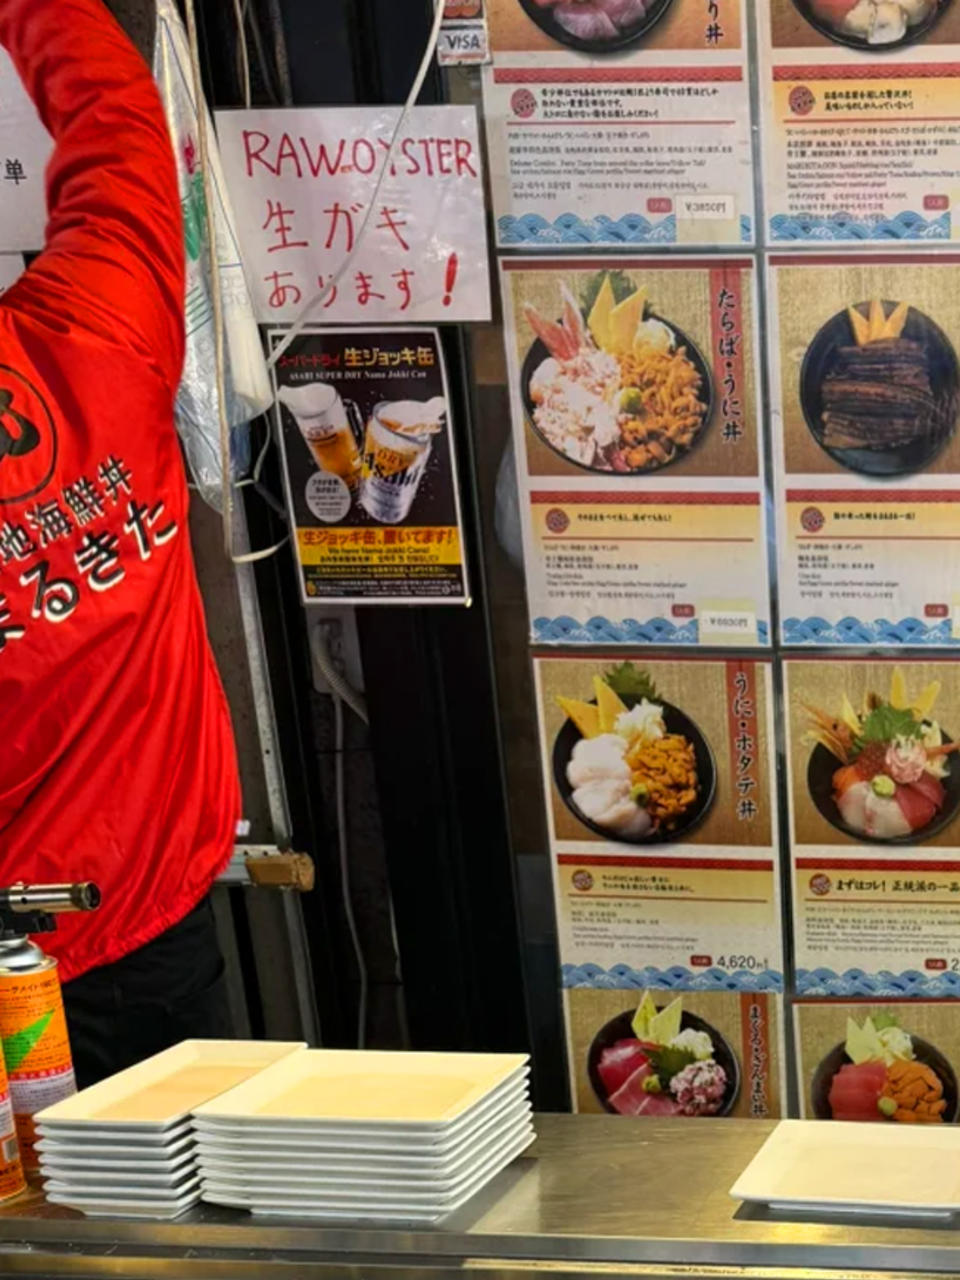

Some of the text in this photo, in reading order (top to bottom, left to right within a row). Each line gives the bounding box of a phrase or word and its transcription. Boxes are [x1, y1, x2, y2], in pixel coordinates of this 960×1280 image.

[445, 34, 480, 49] VISA
[344, 347, 434, 367] 生ジョッキ缶
[717, 287, 744, 442] たらば・うに丼
[734, 672, 758, 820] うに・ホタテ丼
